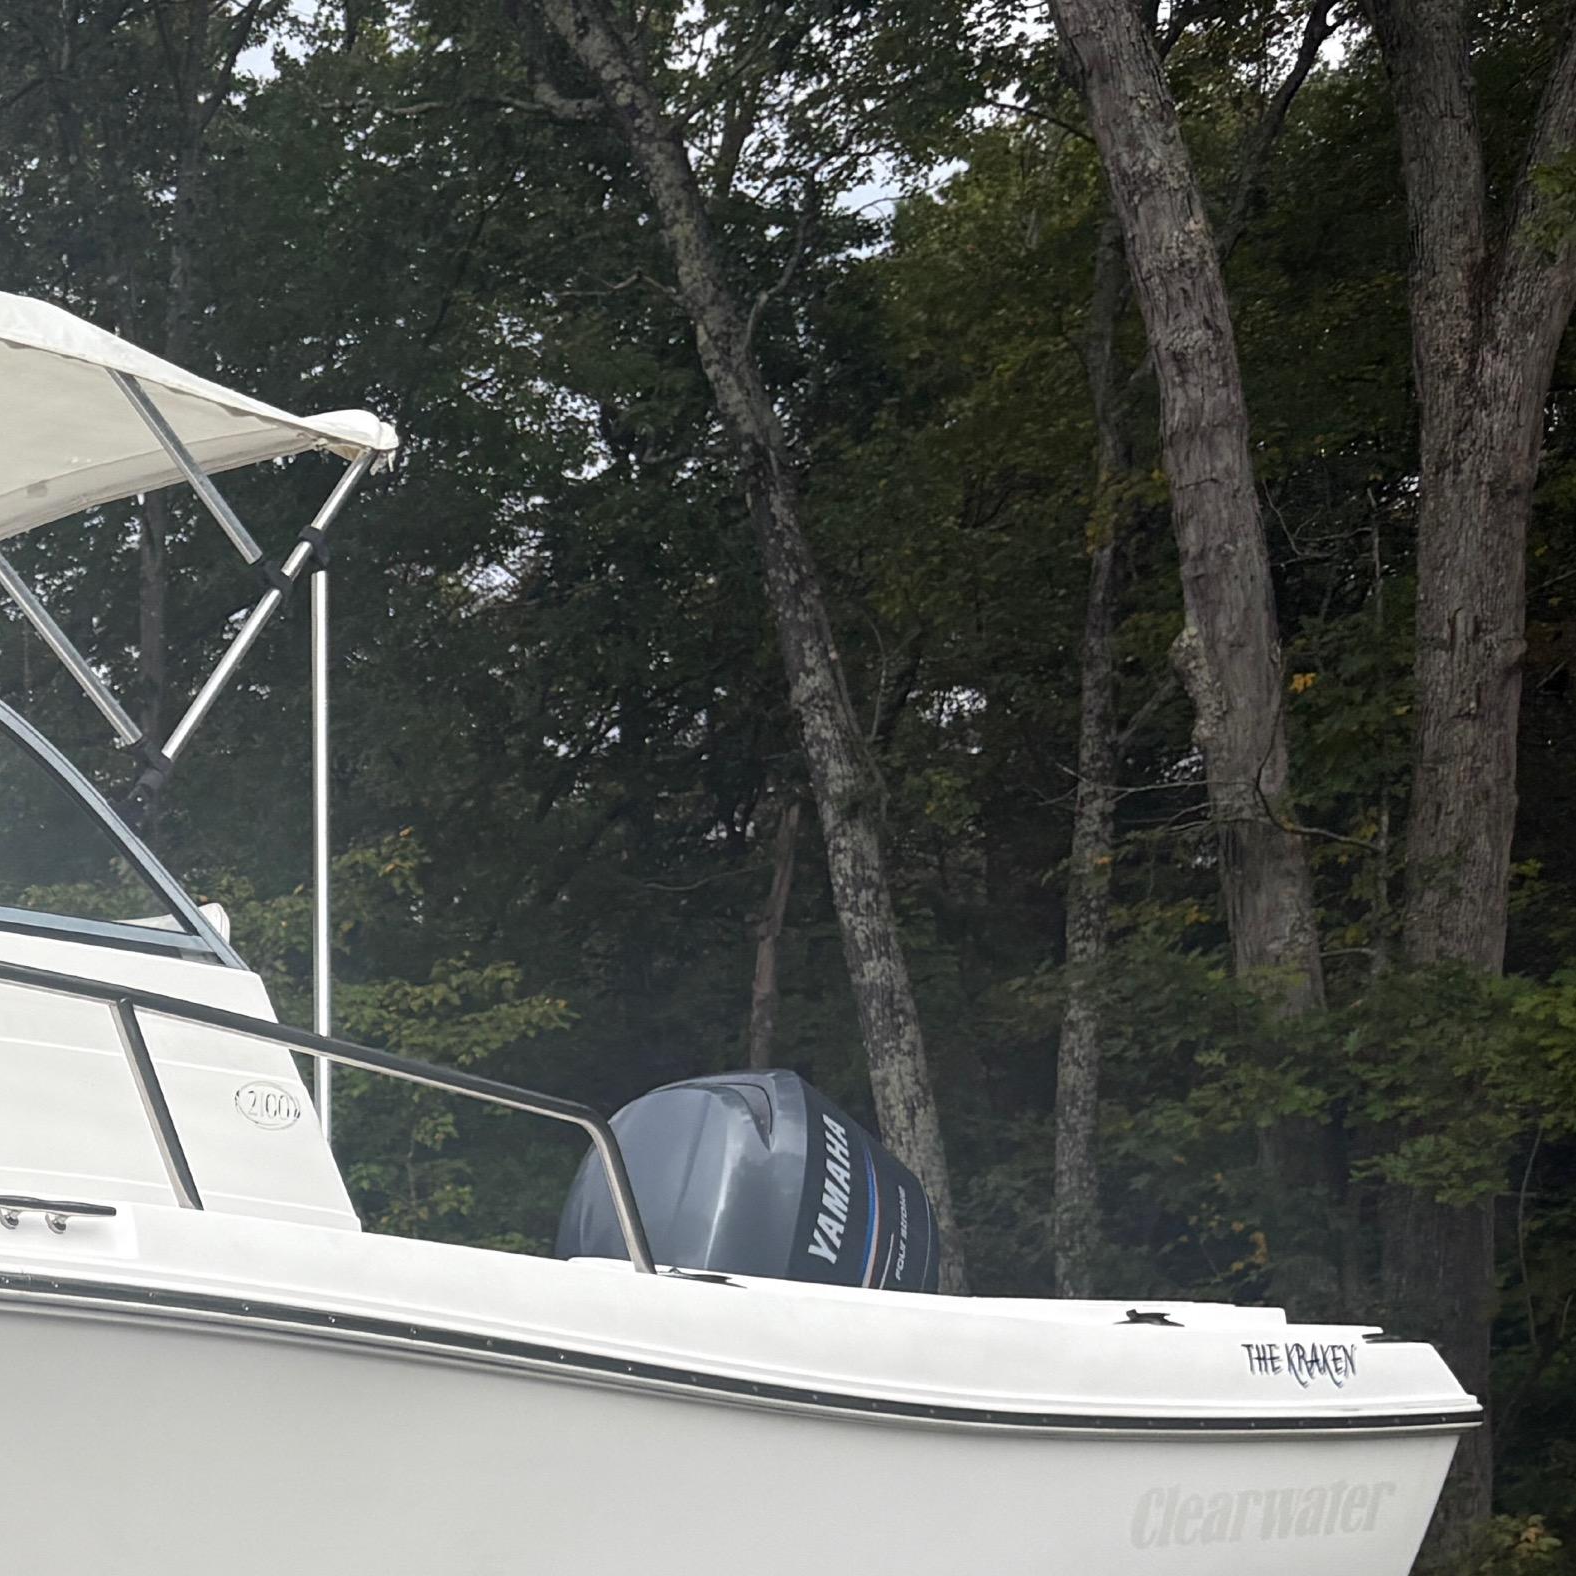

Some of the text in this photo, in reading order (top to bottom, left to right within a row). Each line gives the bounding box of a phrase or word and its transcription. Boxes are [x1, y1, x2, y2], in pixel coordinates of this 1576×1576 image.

[807, 1113, 851, 1265] YAMAHA
[1240, 1341, 1358, 1389] THE KRAKEN
[1129, 1477, 1397, 1550] Clearwater
